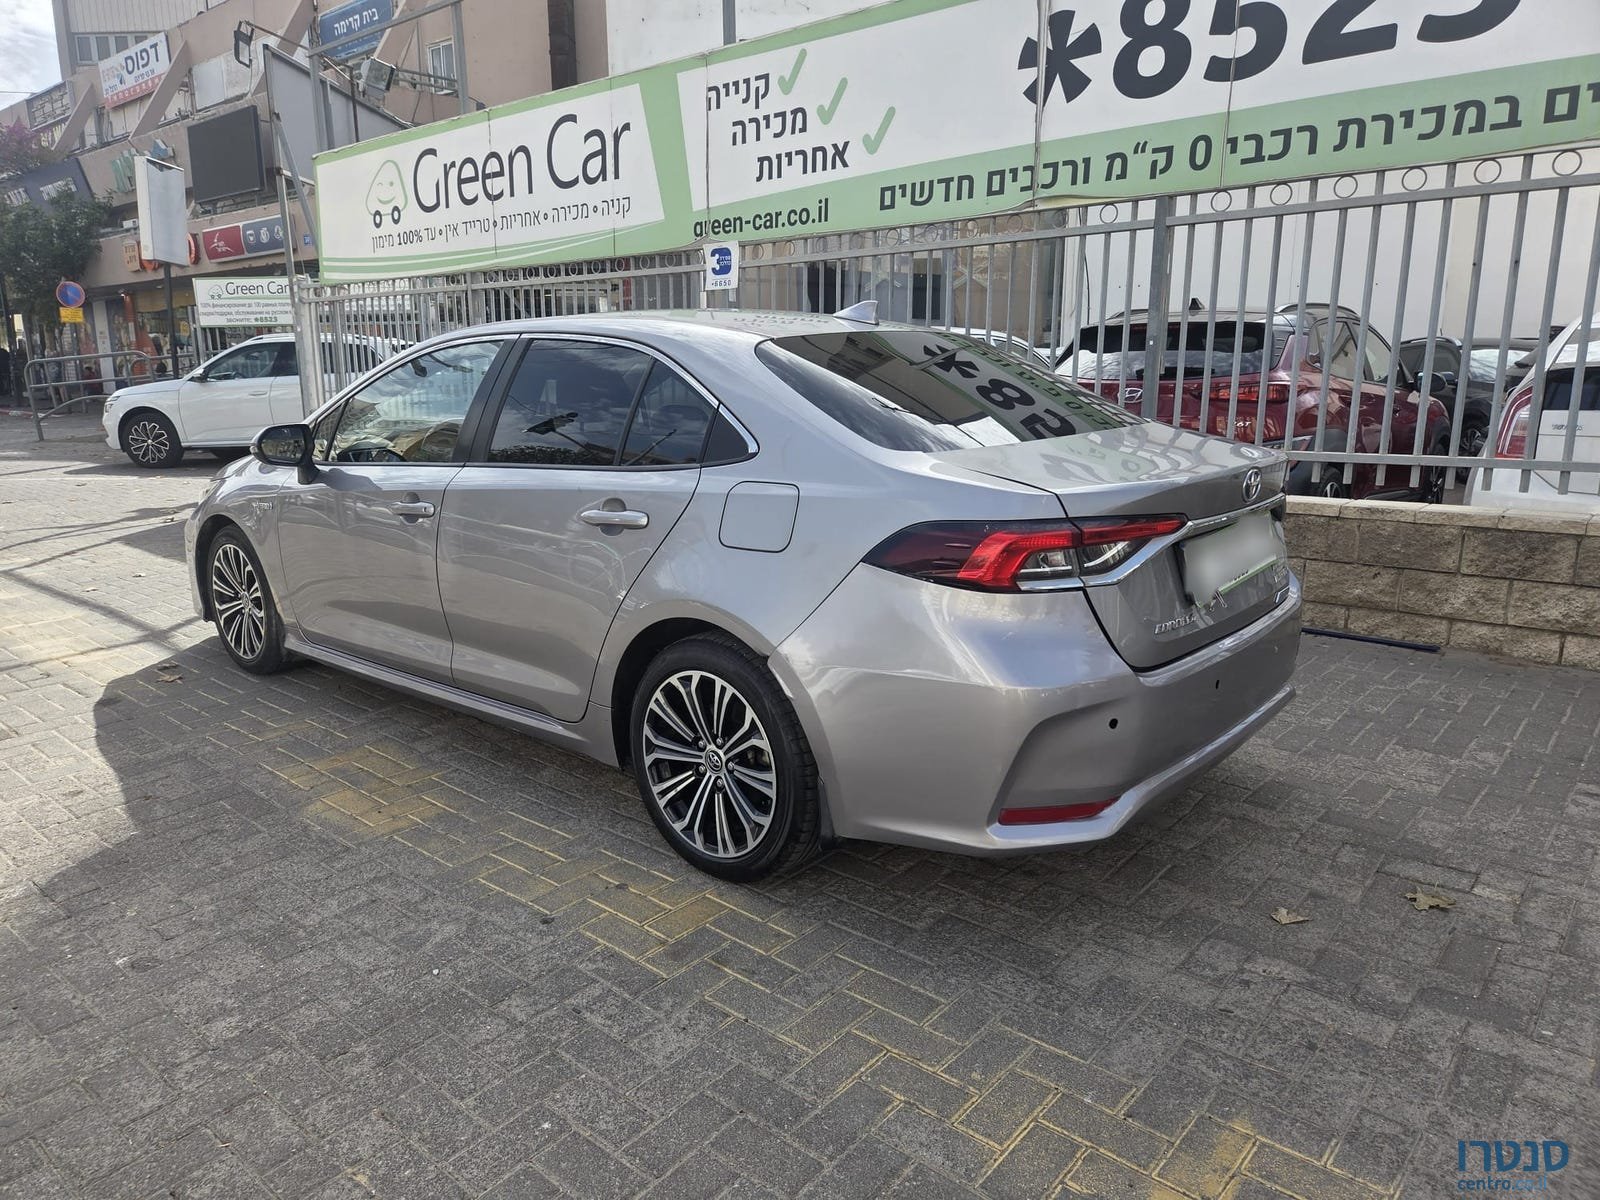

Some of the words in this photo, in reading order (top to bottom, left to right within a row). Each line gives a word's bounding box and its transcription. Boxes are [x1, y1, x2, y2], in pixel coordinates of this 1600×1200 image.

[362, 8, 379, 25] בית
[124, 41, 159, 75] דפוס
[707, 73, 770, 111] קנייה
[1542, 82, 1600, 124] ים
[732, 106, 808, 146] מכירה
[1332, 95, 1523, 152] במכירת
[756, 141, 850, 182] אחריות
[1189, 134, 1213, 171] 0
[1226, 124, 1319, 166] רכבי
[413, 144, 534, 214] Green
[547, 113, 631, 189] Car
[986, 157, 1092, 198] ורכבים
[601, 196, 631, 218] קניה
[879, 174, 975, 211] חדשים
[462, 218, 490, 236] טרייד
[500, 210, 541, 231] אחריות
[552, 203, 589, 223] מכירה
[693, 197, 829, 240] green-car.co.il
[371, 234, 395, 254] מימון
[397, 228, 423, 246] 100%
[424, 227, 437, 241] עד
[444, 222, 460, 243] אין
[225, 281, 264, 296] Green
[267, 280, 290, 295] Car
